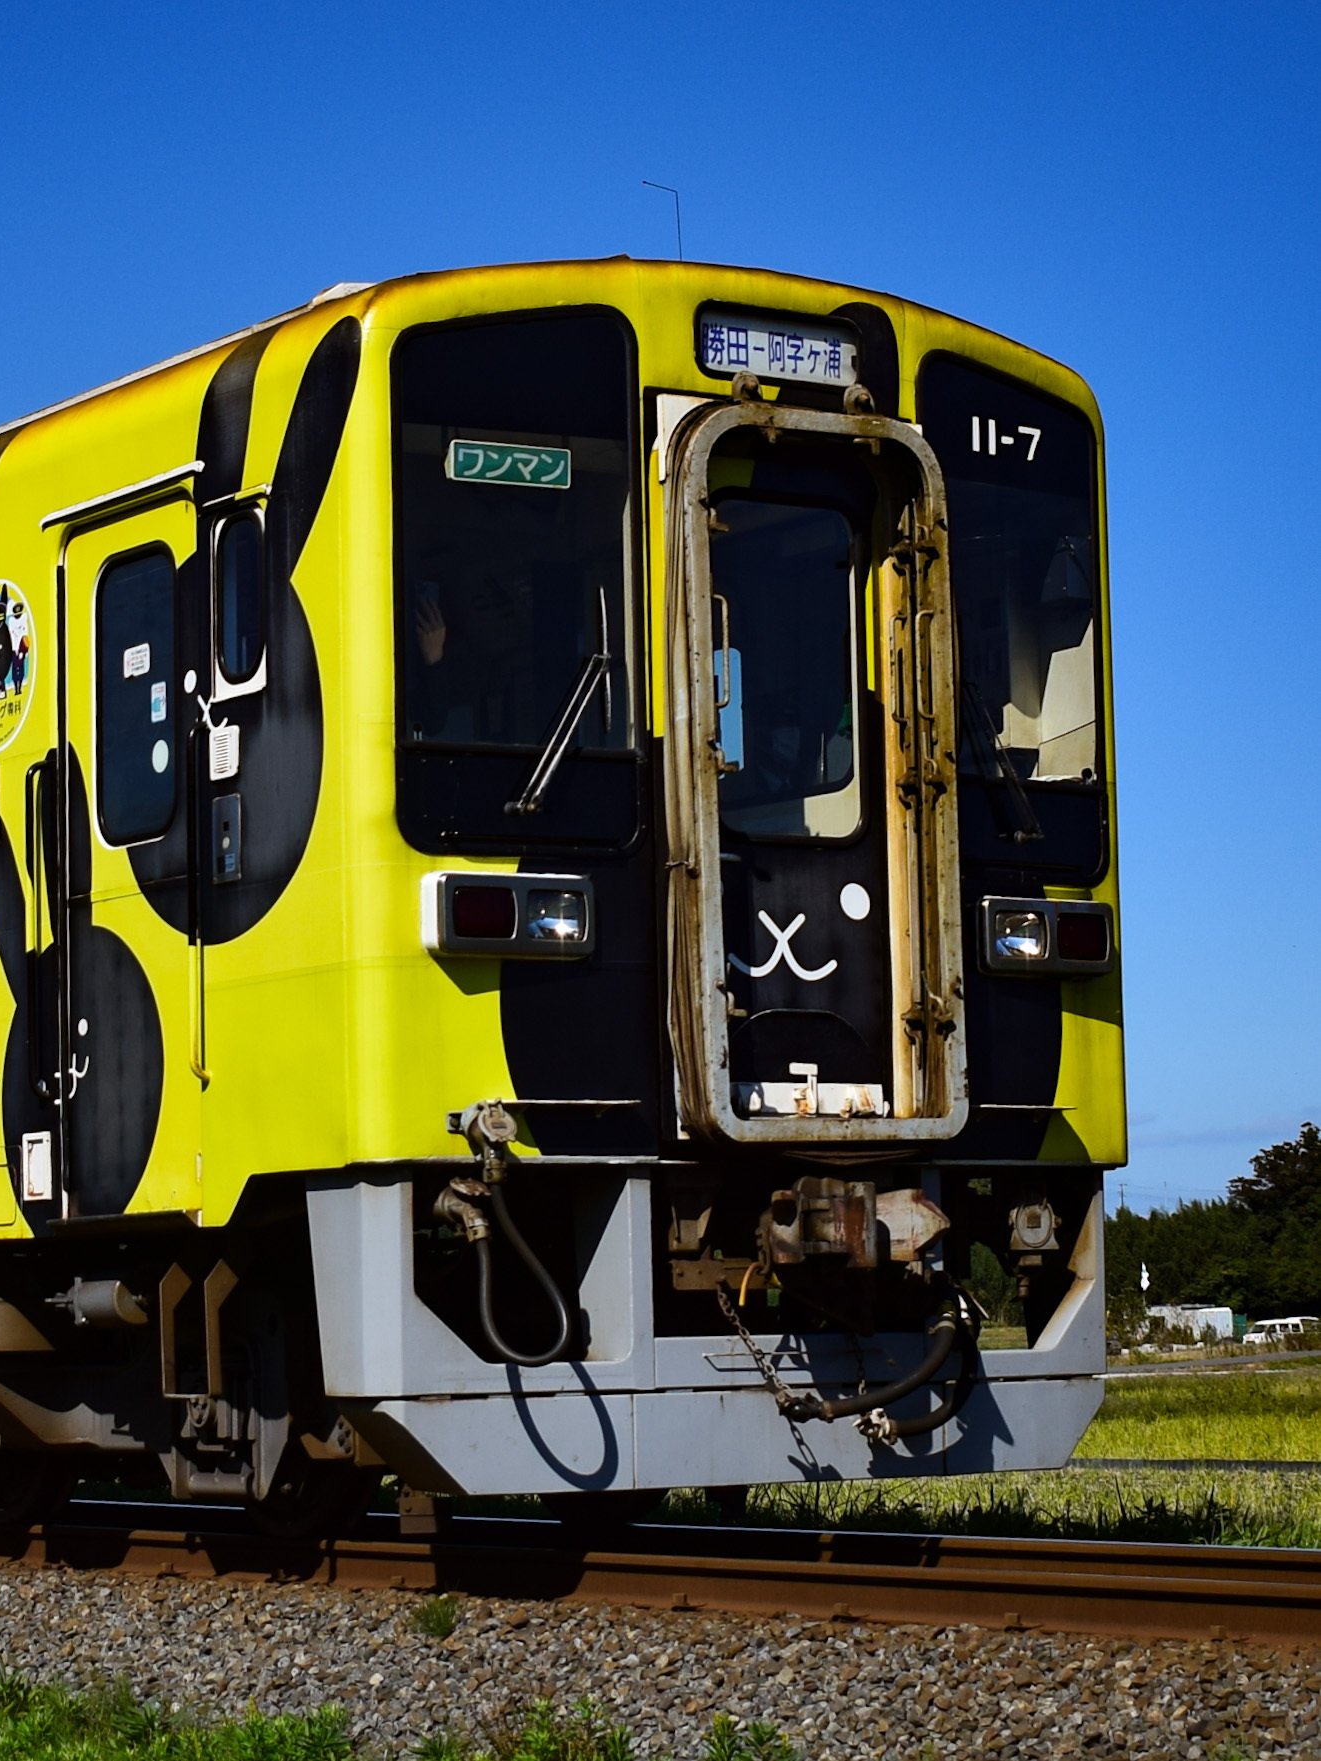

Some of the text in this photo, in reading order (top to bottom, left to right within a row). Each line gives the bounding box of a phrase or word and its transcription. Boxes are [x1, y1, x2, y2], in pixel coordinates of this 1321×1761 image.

[970, 415, 1042, 462] 11-7
[457, 446, 566, 482] ワンマン
